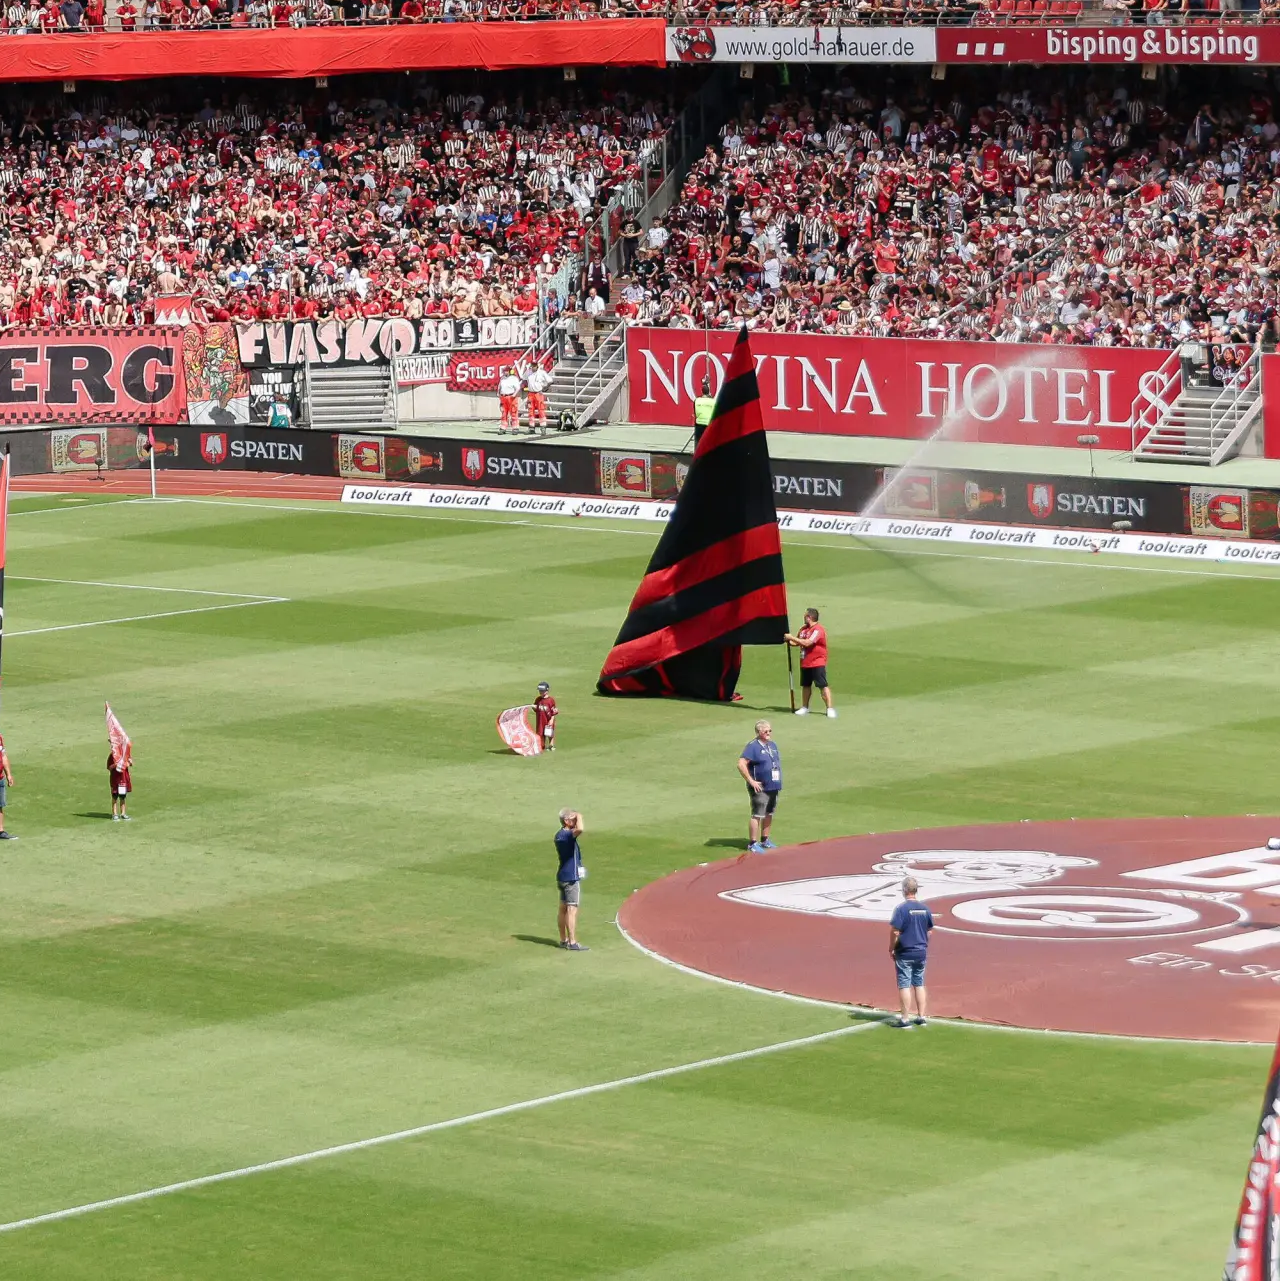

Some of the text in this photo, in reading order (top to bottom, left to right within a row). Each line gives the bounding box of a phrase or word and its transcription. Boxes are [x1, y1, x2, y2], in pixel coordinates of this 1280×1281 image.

[725, 35, 915, 62] www.gold-hanauer.de
[1046, 29, 1259, 62] bisping & bisping
[235, 319, 416, 365] FIASKO
[262, 372, 283, 384] YOU
[396, 357, 449, 380] H3RZBLUT
[250, 383, 273, 395] WILL
[639, 347, 1170, 431] NOINA HOTELS
[230, 439, 303, 462] SPATEN
[487, 456, 562, 479] SPATEN
[773, 475, 843, 498] PATEN
[1057, 491, 1144, 517] SPATEN
[350, 487, 413, 503] toolcraft
[429, 491, 491, 507] toolcraft
[504, 496, 566, 512] toolcraft
[581, 500, 640, 517] toolcraft
[808, 516, 871, 533] toolcraft
[887, 522, 953, 540] toolcraft
[969, 527, 1036, 545] toolcraft
[1053, 531, 1121, 551] toolcaft
[1139, 537, 1208, 557] toolcraft
[1127, 951, 1213, 970] Ein
